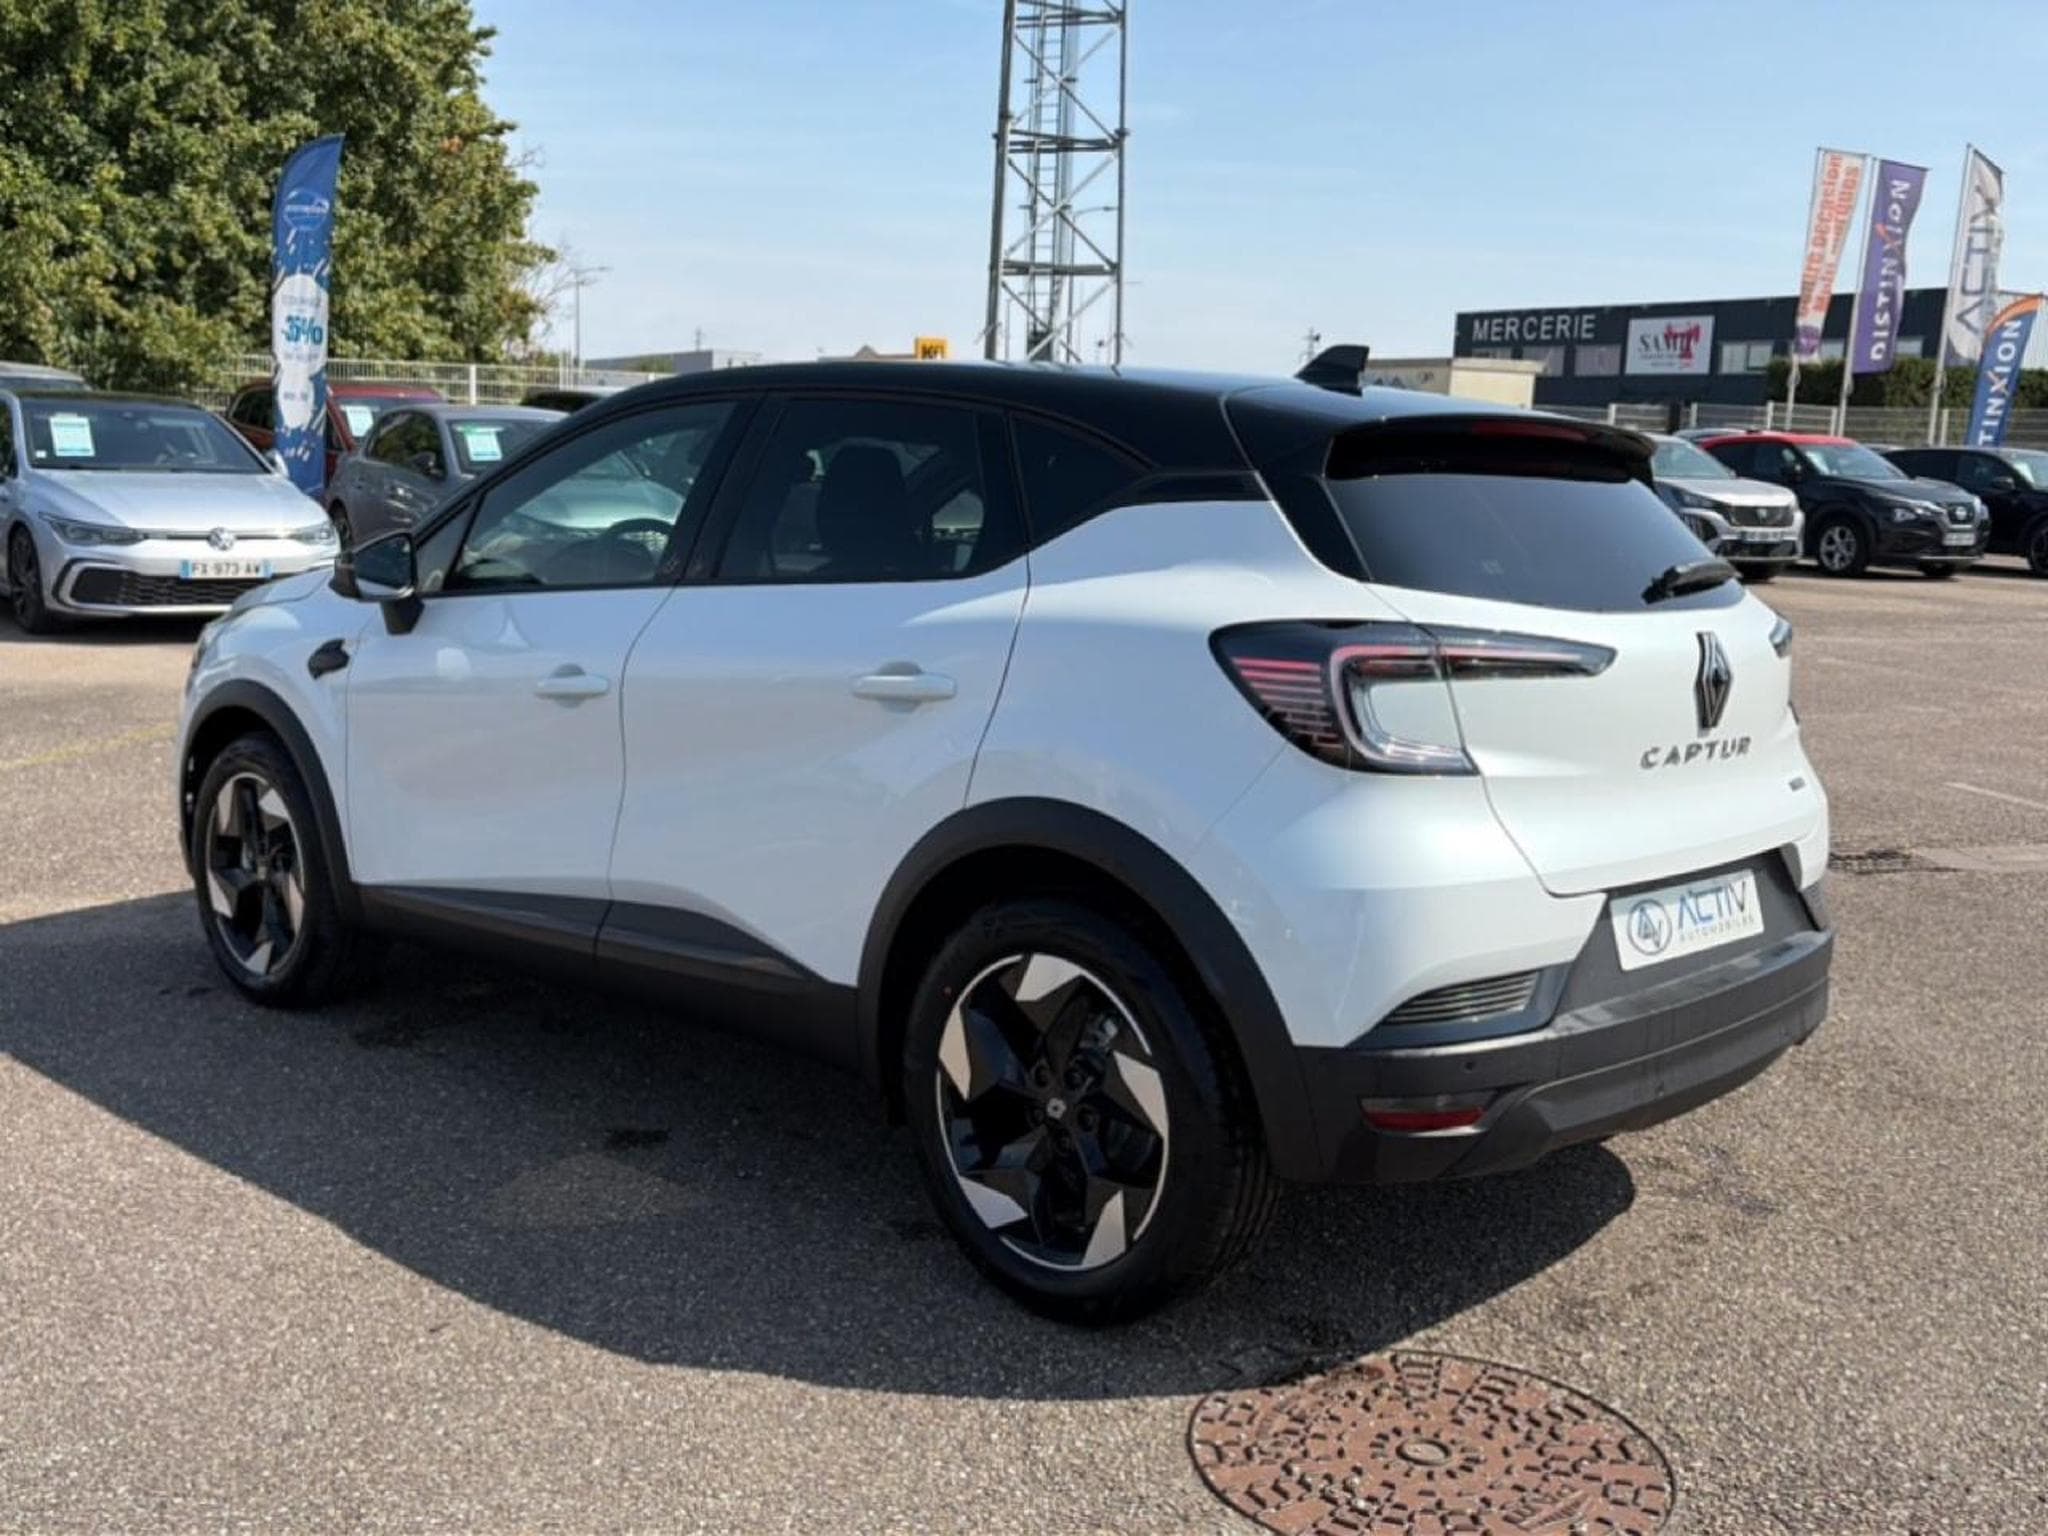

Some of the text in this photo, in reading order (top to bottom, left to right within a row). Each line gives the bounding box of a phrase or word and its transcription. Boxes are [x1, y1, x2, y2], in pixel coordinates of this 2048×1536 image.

[1871, 179, 1911, 361] DISTINXION
[1956, 184, 1998, 335] ACTIV
[1471, 314, 1597, 342] MERCERIE
[1640, 736, 1752, 770] CAPTUR
[1678, 881, 1747, 930] ACTIV
